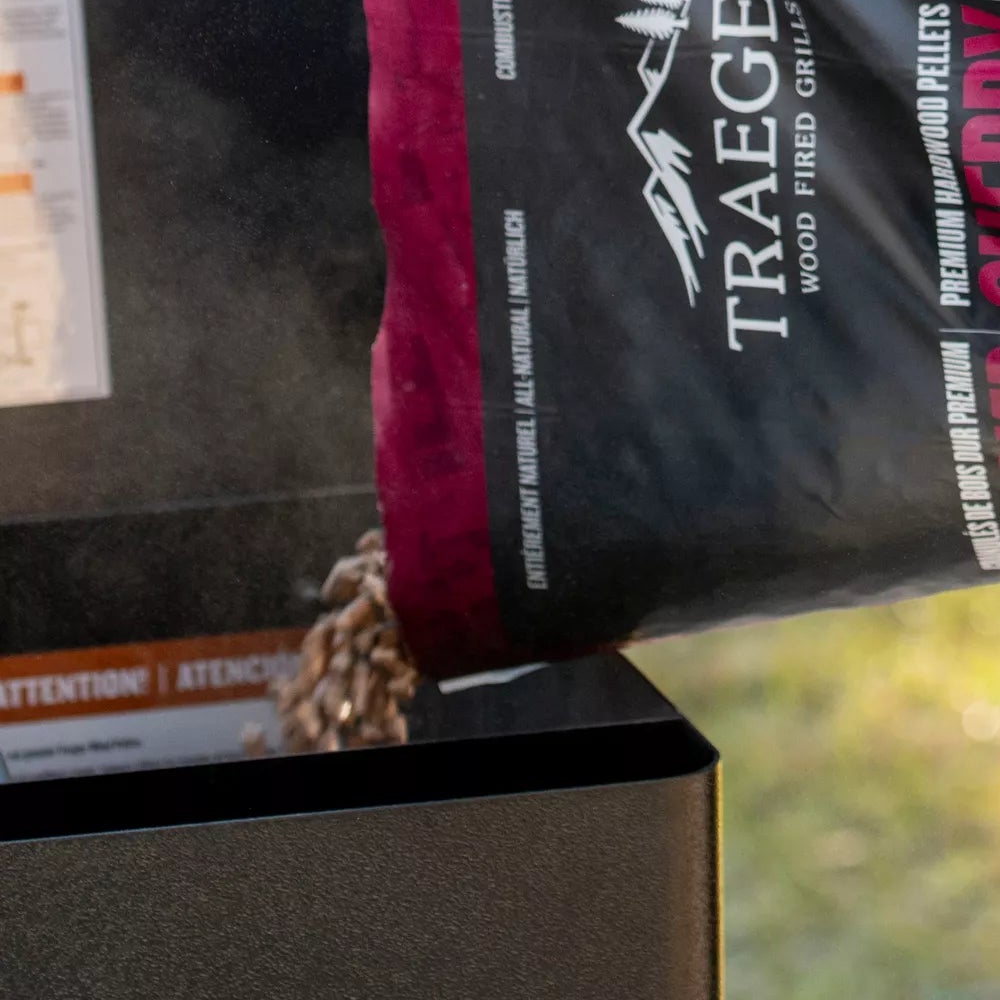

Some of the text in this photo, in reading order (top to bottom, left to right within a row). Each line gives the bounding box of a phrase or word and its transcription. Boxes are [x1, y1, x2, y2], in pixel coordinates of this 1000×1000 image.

[784, 0, 821, 294] WOOD FIRED GRILLS
[916, 2, 971, 306] PREMIUM HARDWOOD PELLETS
[502, 208, 528, 297] NATÜRLICH
[509, 307, 535, 407] ALL-NATURAL
[940, 341, 978, 424] PREMIUM
[515, 418, 540, 485] NATUREL
[949, 427, 984, 463] DUR
[955, 464, 992, 500] BOIS
[962, 501, 996, 521] DE
